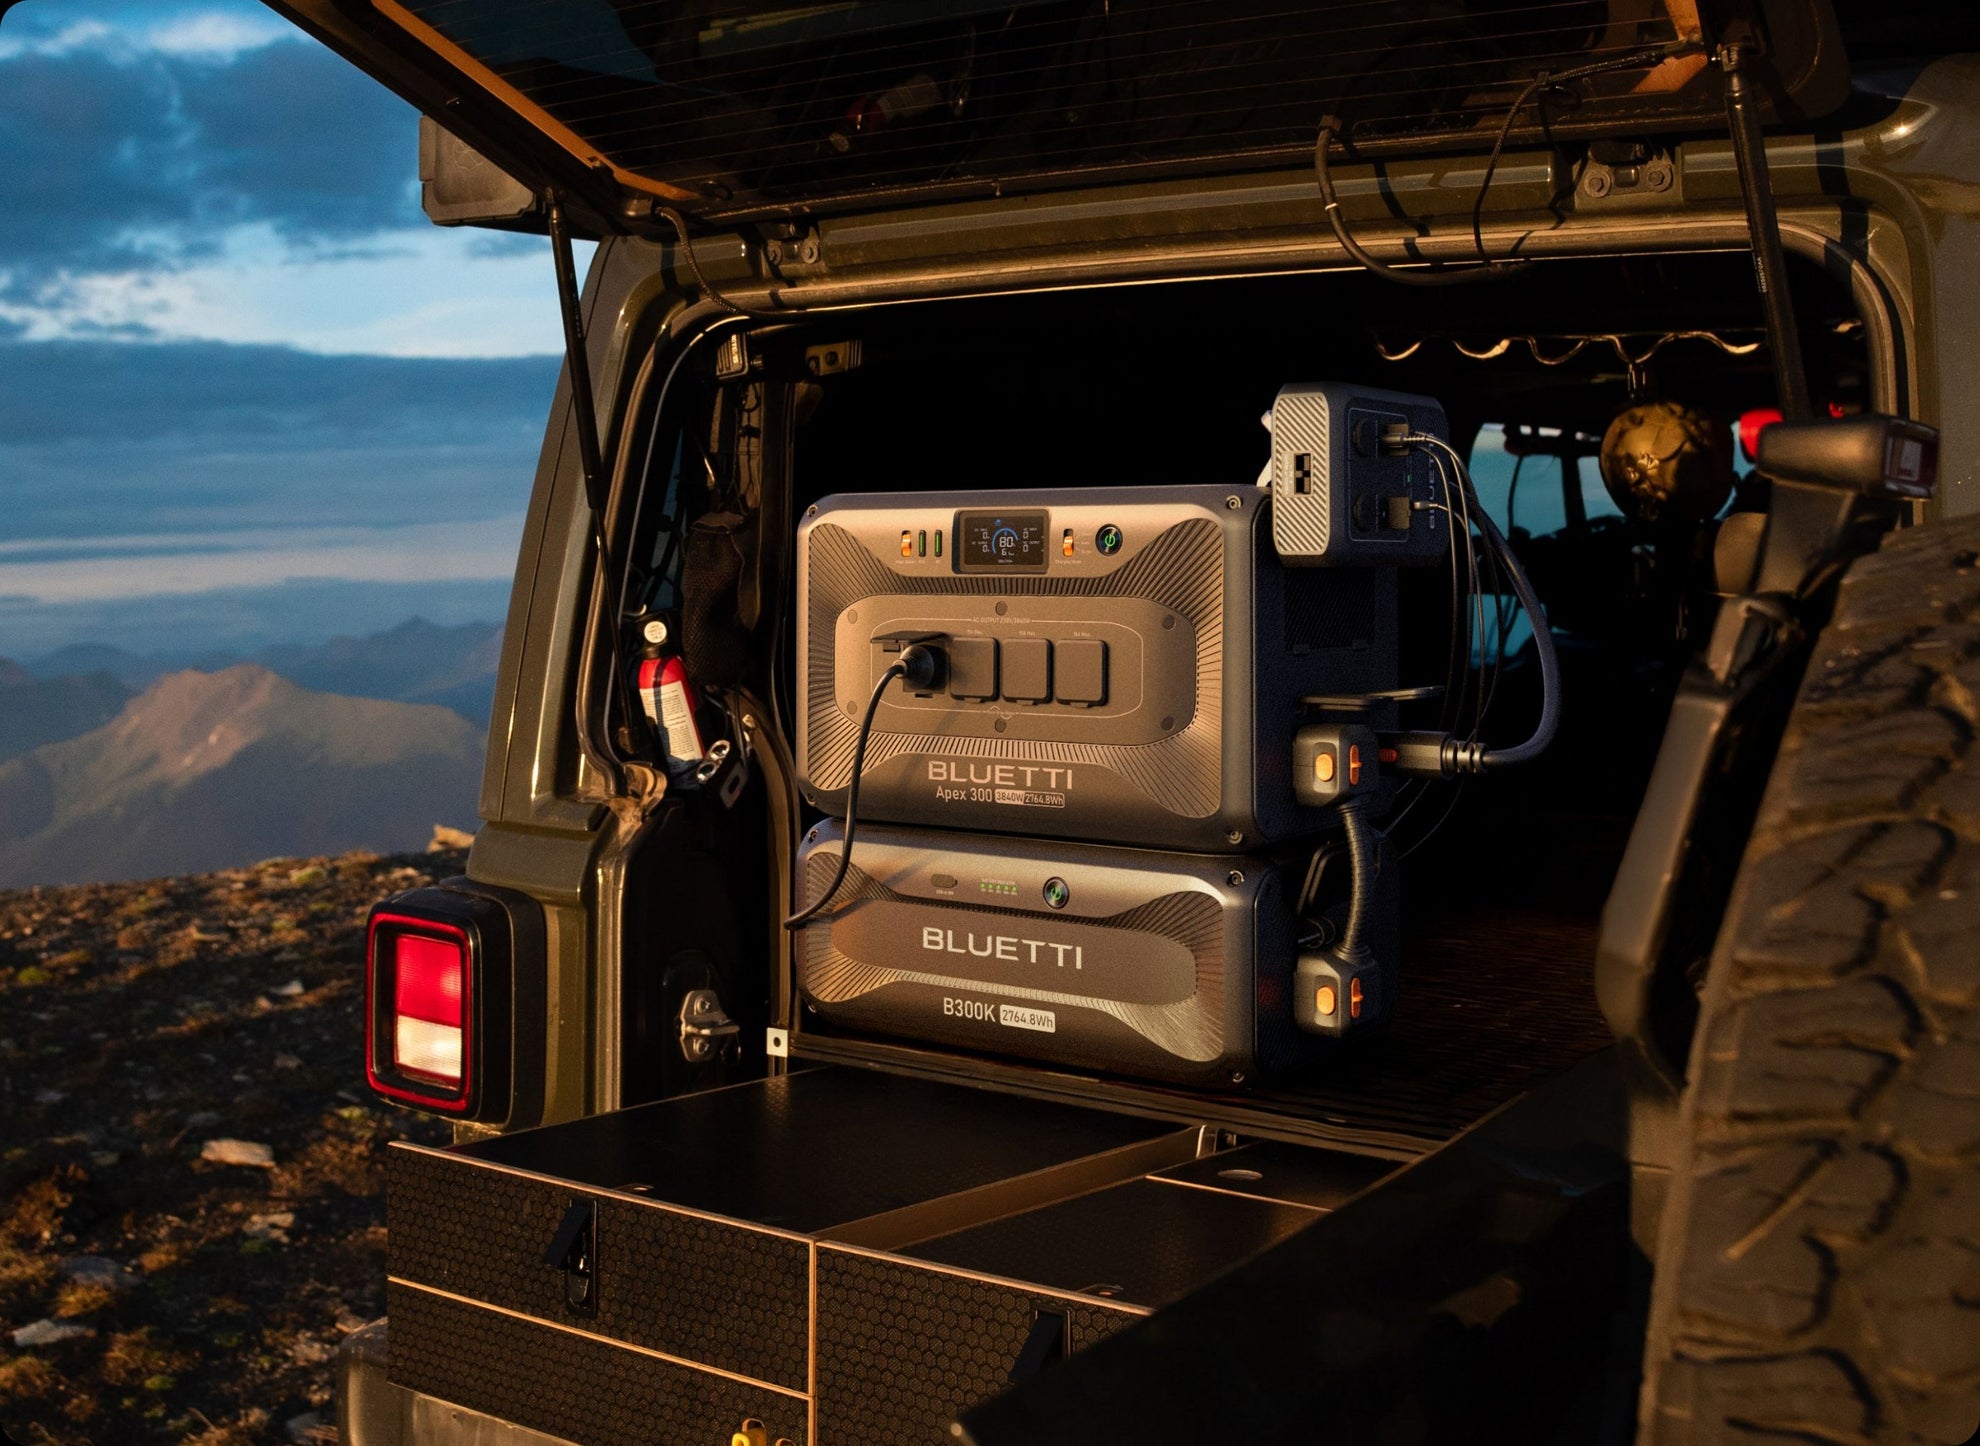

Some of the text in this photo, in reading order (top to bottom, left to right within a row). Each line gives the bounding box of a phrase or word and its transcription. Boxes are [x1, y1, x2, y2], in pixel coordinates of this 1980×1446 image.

[928, 760, 1073, 790] BLUETTI
[936, 785, 1063, 806] Apex 300 3840W 2764.8Wh
[922, 926, 1083, 970] BLUETTI
[943, 997, 1054, 1029] B300K 2764.8Wh
